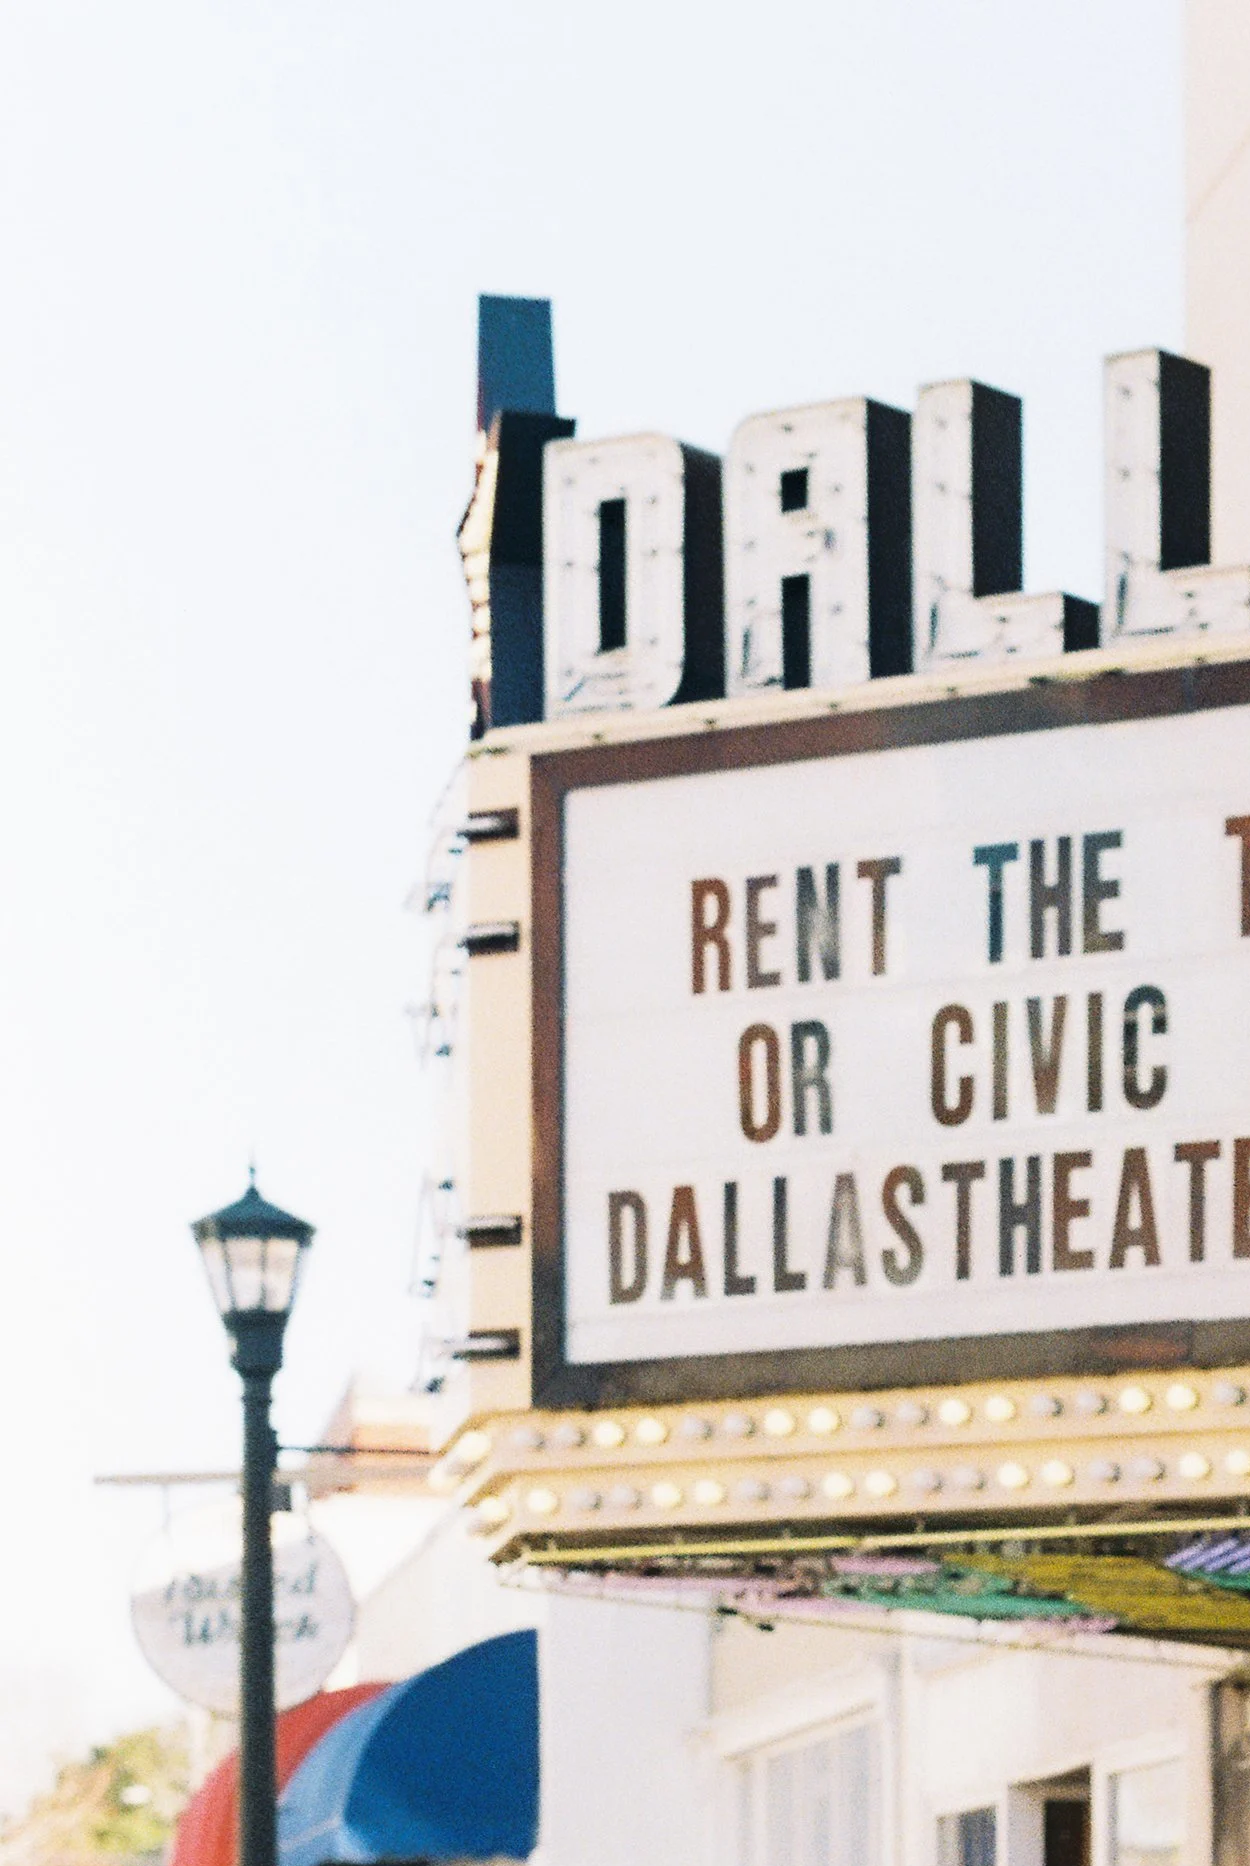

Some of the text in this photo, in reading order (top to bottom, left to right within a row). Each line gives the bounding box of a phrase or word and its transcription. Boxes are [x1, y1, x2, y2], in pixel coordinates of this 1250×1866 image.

[690, 857, 903, 995] RENT
[972, 829, 1126, 965] THE
[737, 1019, 834, 1144] OR
[930, 984, 1169, 1128] CIVIC
